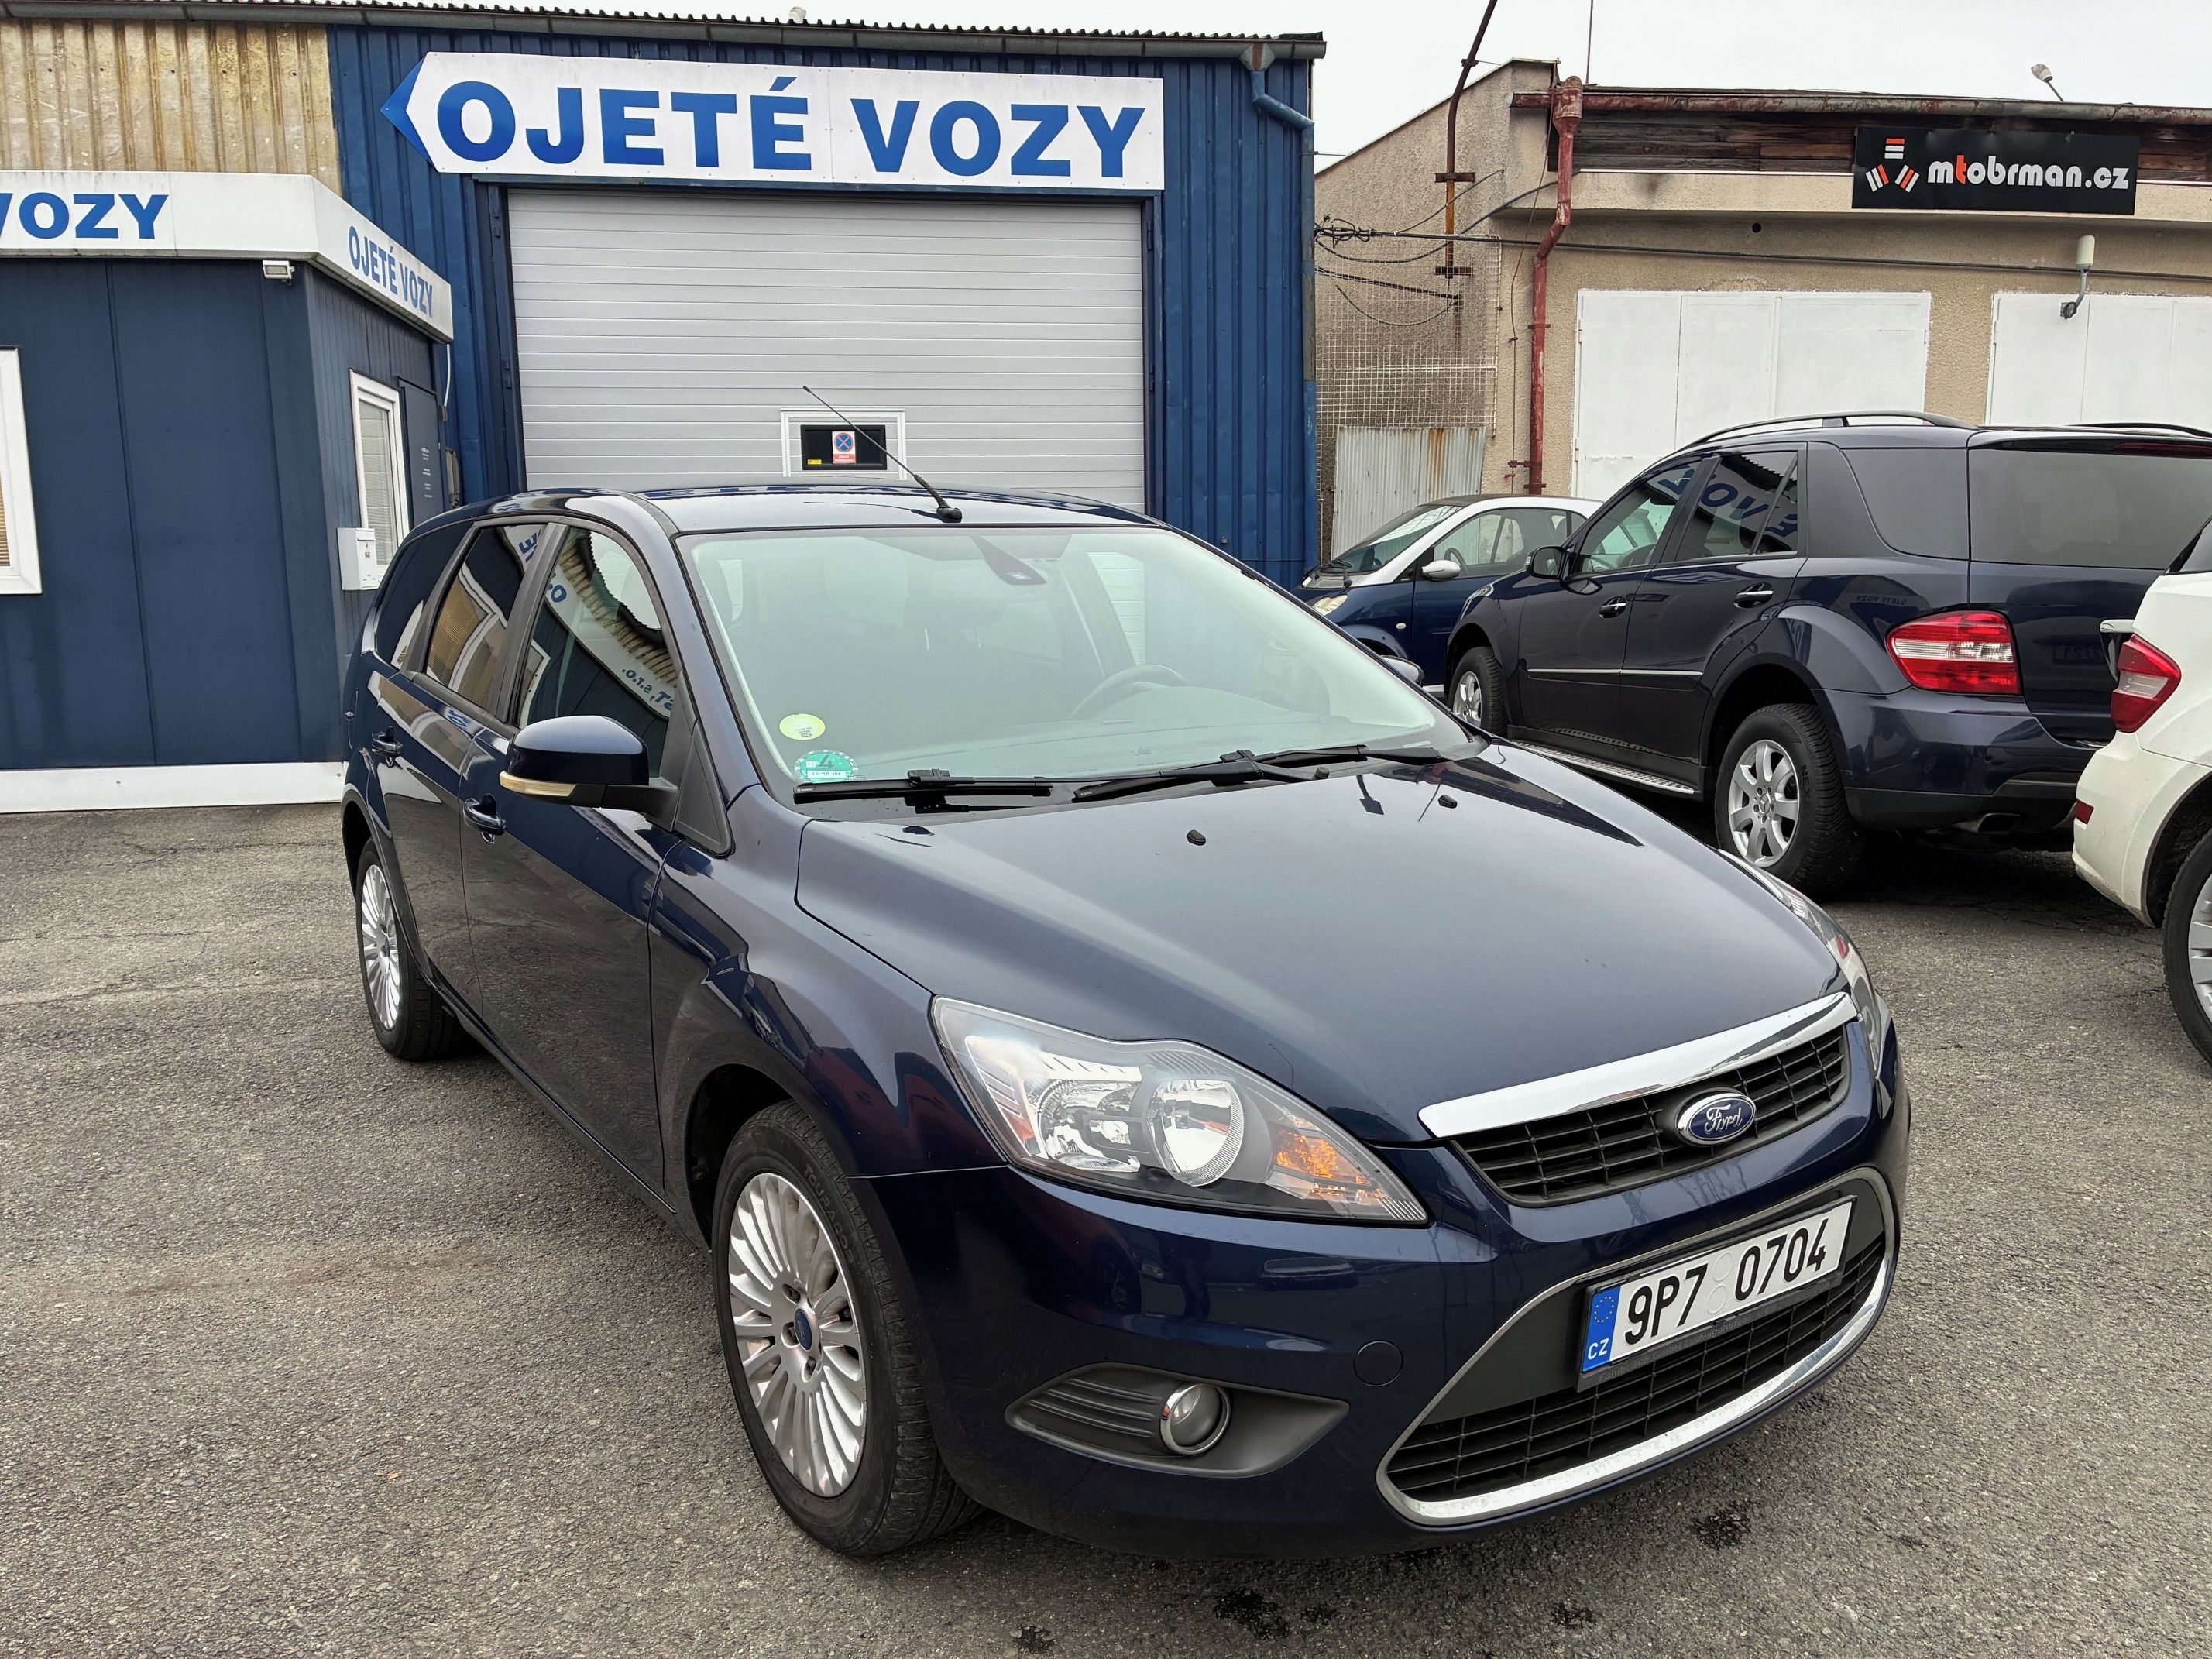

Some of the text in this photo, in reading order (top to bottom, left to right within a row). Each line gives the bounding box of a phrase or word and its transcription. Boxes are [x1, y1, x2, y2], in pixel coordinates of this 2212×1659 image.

[438, 76, 1146, 177] OJETÉ VOZY
[1927, 155, 2130, 190] mtobrman.cz
[349, 225, 433, 318] OJETÉ VOZY
[819, 754, 835, 770] 4
[1705, 1104, 1743, 1135] Ford
[1624, 1217, 1829, 1345] 9P7 0704
[1588, 1338, 1609, 1361] CZ
